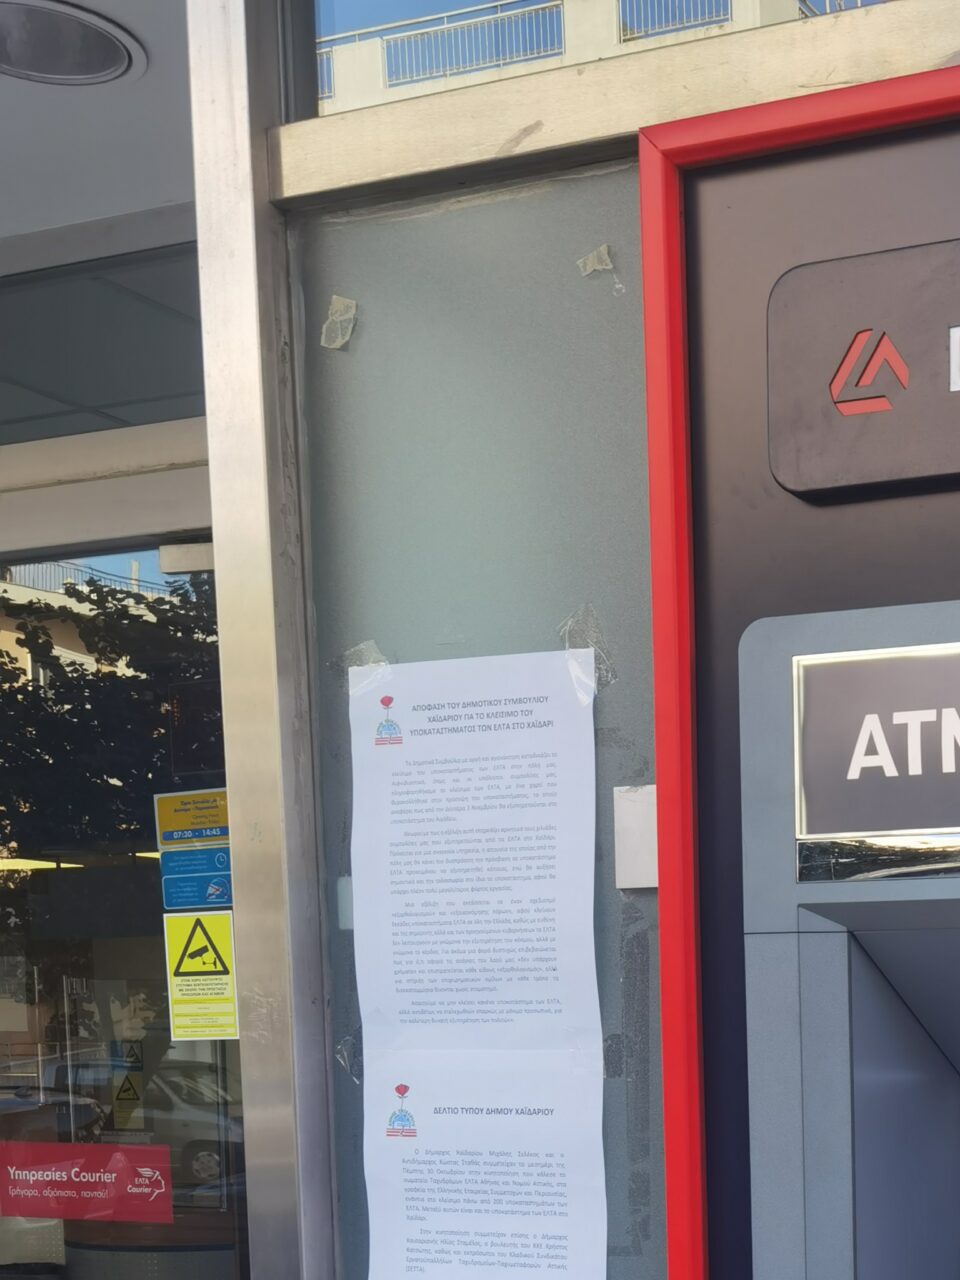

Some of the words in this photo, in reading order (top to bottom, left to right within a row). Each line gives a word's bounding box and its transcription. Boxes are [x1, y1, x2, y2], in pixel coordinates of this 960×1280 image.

[411, 703, 446, 712] ΑΠΟΦΑΣΗ
[461, 699, 502, 709] ΔΗΜΟΤΙΚΟΥ
[503, 696, 549, 705] ΣΥΜΒΟΥΛΙΟΥ
[427, 713, 463, 723] ΧΑΪΔΑΡΙΟΥ
[486, 710, 519, 719] ΚΛΕΙΣΙΜΟ
[520, 709, 533, 717] ΤΟΥ
[409, 725, 476, 736] ΥΠΟΚΑΤΑΣΤΗΜΑΤΟΣ
[493, 723, 511, 731] ΕΛΤΑ
[511, 722, 525, 730] ΣΤΟ
[526, 719, 554, 728] ΧΑΪΔΑΡΙ
[433, 1107, 459, 1115] ΔΕΛΤΙΟ
[460, 1107, 484, 1115] ΤΥΠΟΥ
[485, 1107, 513, 1115] ΔΗΜΟΥ
[514, 1106, 554, 1116] ΧΑΪΔΑΡΙΟΥ
[7, 1165, 67, 1184] Υπηρεσίες
[71, 1167, 117, 1183] Courier
[135, 1177, 150, 1185] ΕΛΤΑ
[127, 1185, 152, 1193] Courier
